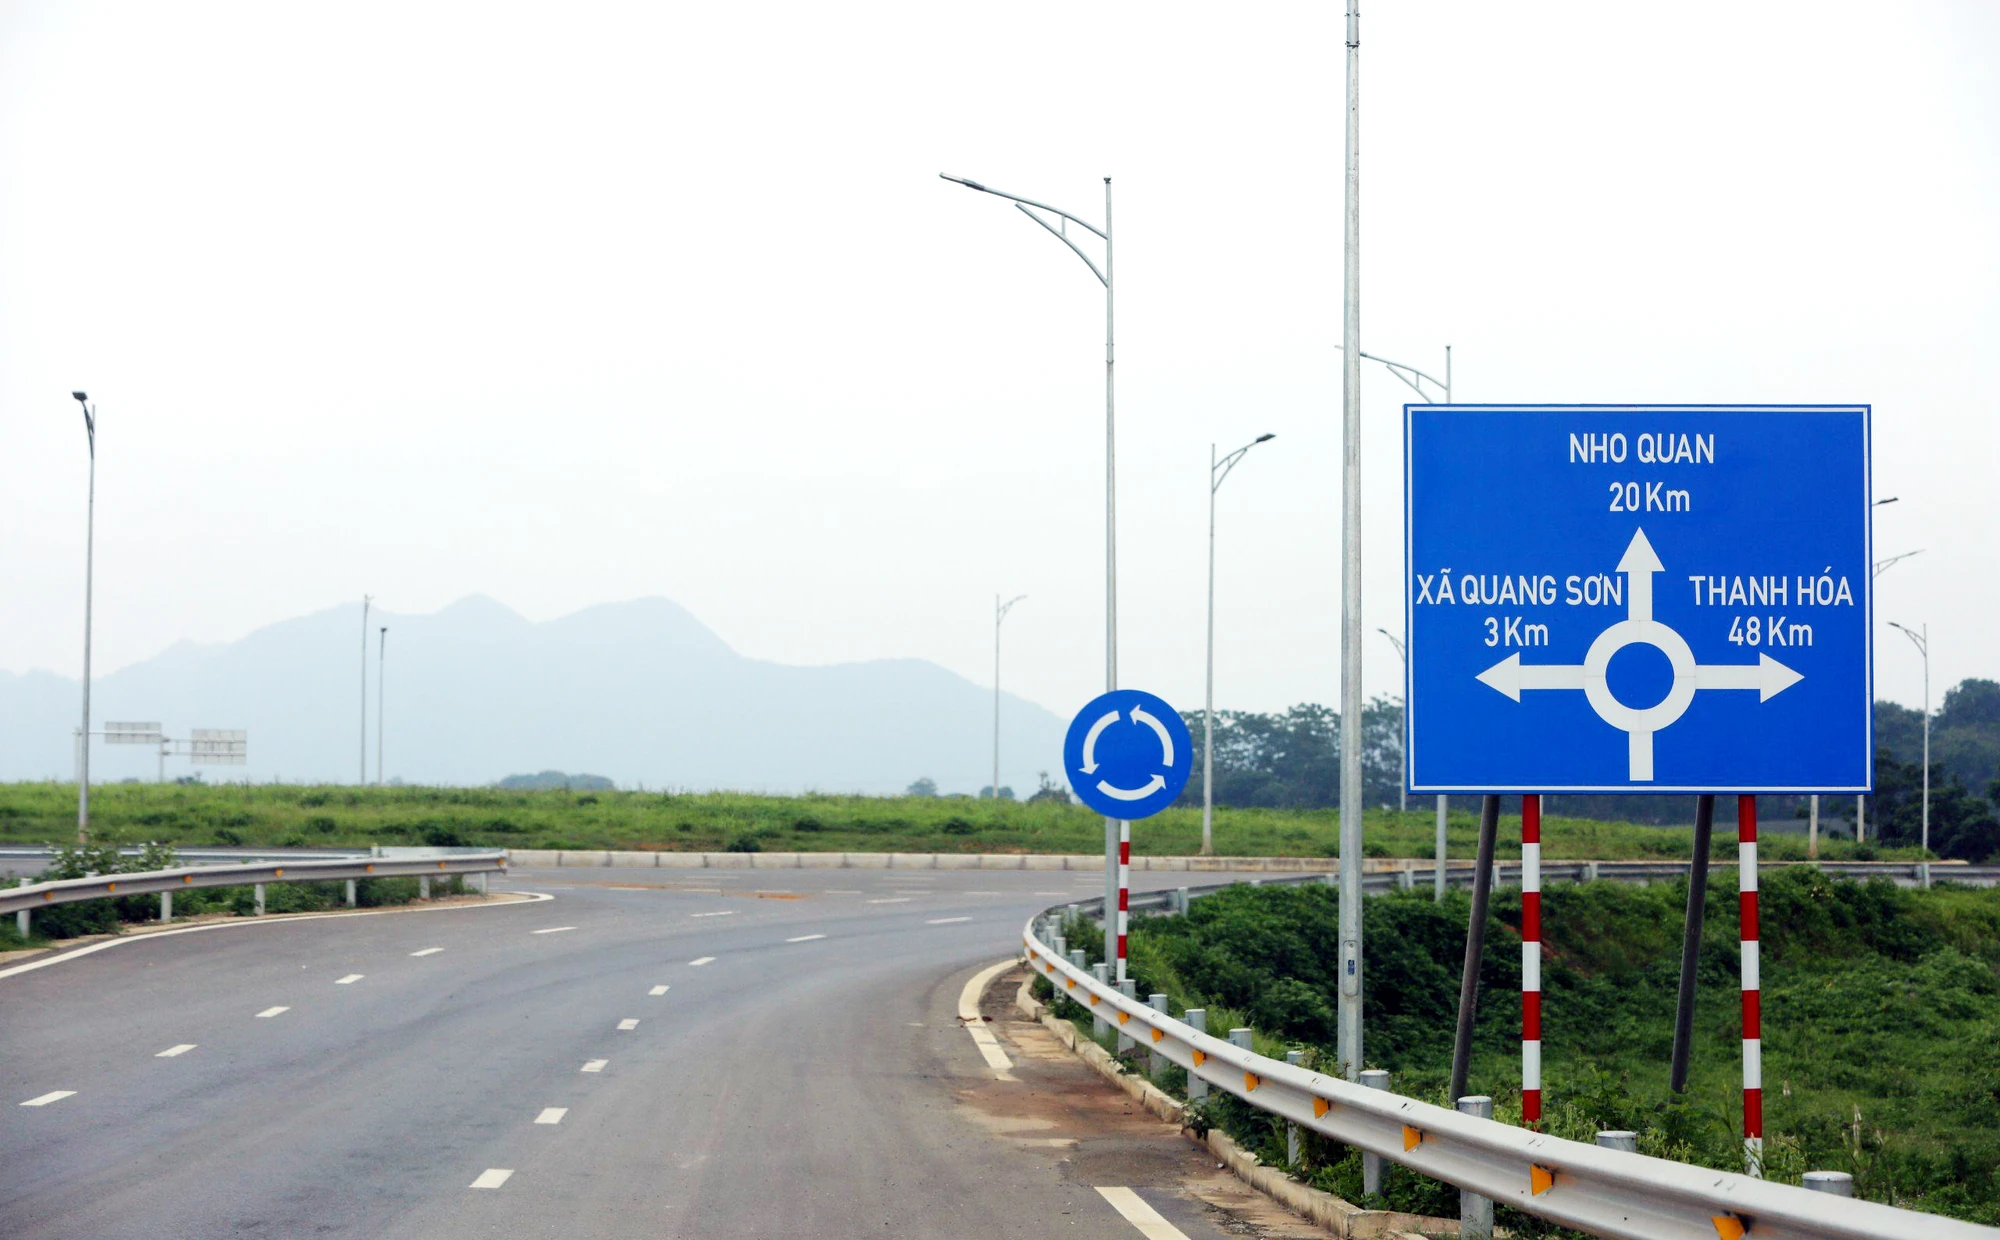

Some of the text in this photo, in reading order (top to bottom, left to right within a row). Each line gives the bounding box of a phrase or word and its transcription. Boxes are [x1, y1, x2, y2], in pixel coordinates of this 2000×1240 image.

[1570, 433, 1714, 463] NHO QUAN
[1610, 482, 1689, 511] 20 Km
[1416, 568, 1623, 605] XÃ QUANG SƠN
[1689, 566, 1853, 605] THANH HÓA
[1485, 617, 1548, 646] 3 Km
[1729, 616, 1812, 646] 48 Km
